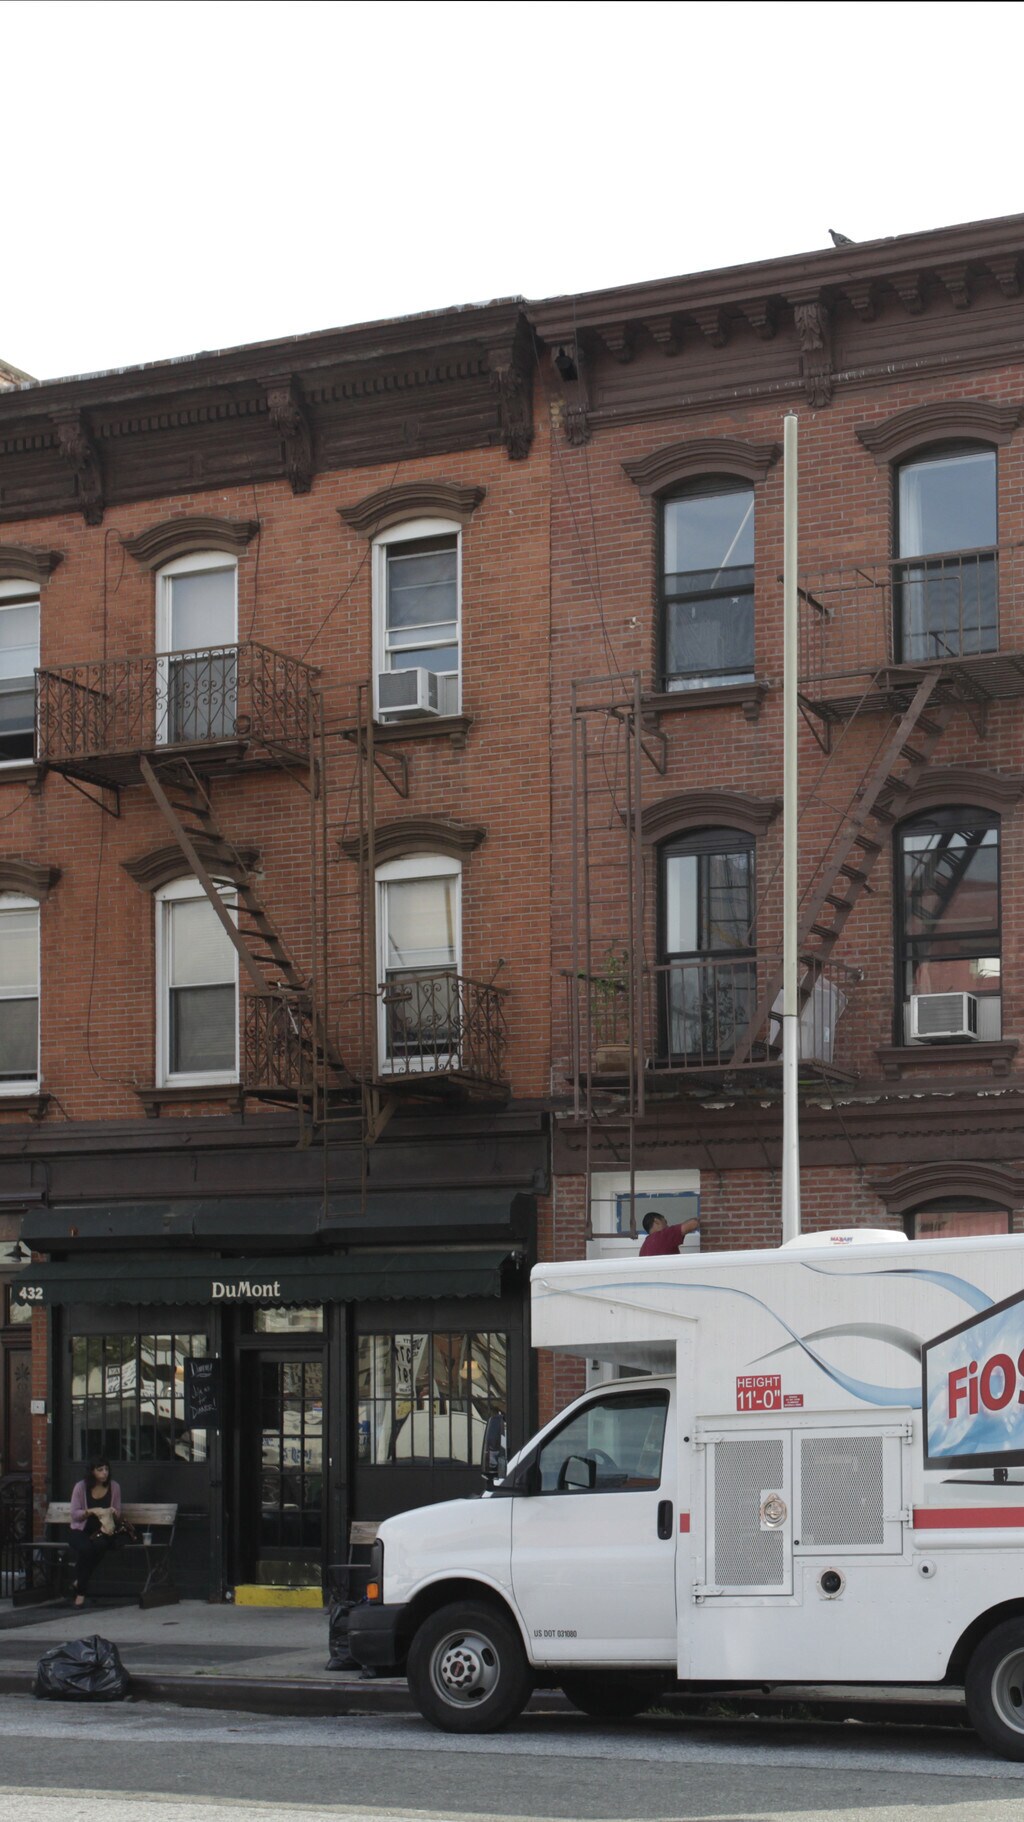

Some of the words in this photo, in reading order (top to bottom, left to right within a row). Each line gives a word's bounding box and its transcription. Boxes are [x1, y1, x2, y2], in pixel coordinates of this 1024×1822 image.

[19, 1287, 44, 1300] 432
[211, 1281, 281, 1298] DuMont
[737, 1376, 780, 1388] HEIGHT
